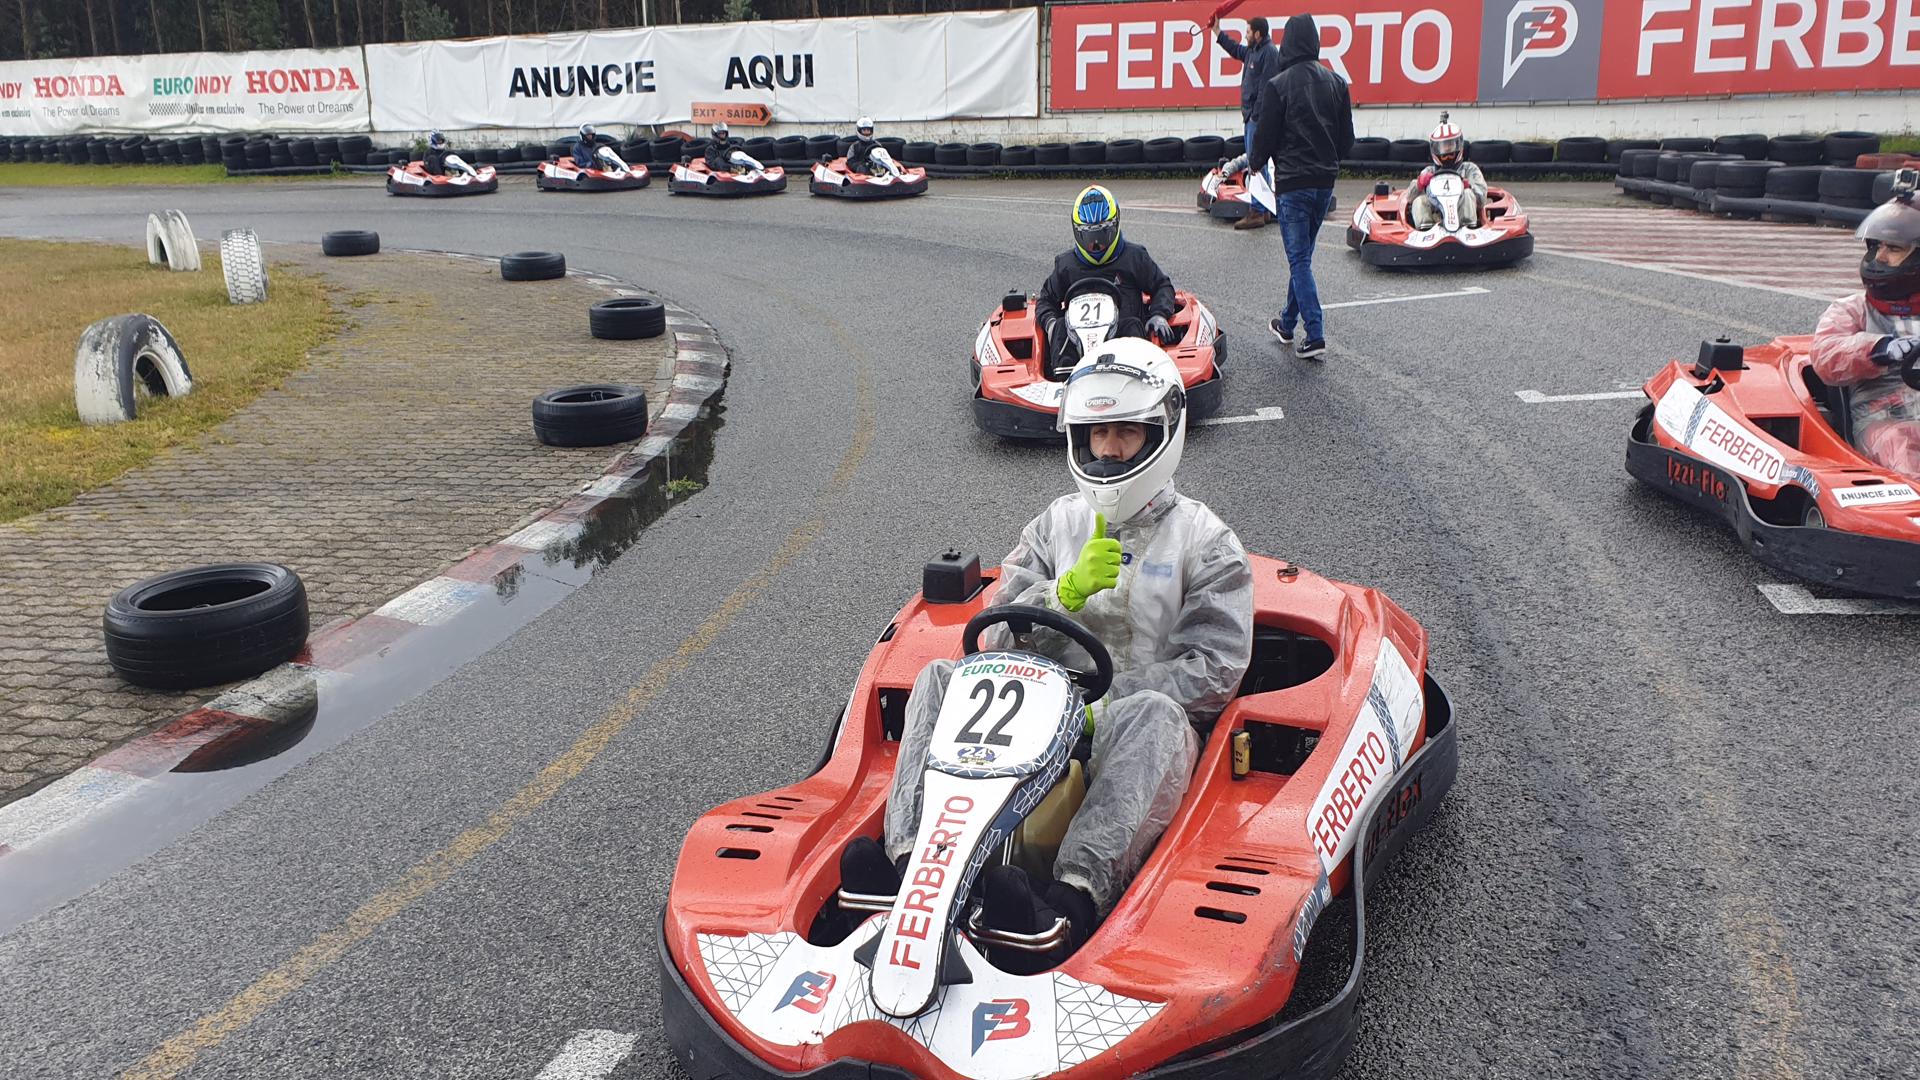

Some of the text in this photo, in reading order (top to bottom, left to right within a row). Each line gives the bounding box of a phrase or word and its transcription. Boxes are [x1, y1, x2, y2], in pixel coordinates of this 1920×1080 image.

[245, 67, 360, 94] HONDA
[508, 53, 815, 98] ANUNCIE AQUI
[33, 74, 125, 98] HONDA
[153, 75, 232, 96] EUROINDY
[42, 106, 55, 117] The
[57, 105, 79, 117] Power
[89, 104, 120, 116] Dreams
[205, 106, 215, 114] em
[216, 102, 245, 115] exclusivo
[258, 101, 354, 115] The Power of Dreams
[692, 108, 716, 117] EXIT
[726, 108, 758, 118] SAÍDA
[1443, 179, 1450, 192] 4
[1080, 302, 1101, 321] 21
[1095, 363, 1141, 377] EUROPA
[1700, 418, 1780, 480] FERBERTO
[1841, 488, 1913, 501] ANUNCIE AQUI
[961, 663, 1049, 681] EUROINDY
[954, 678, 1025, 747] 22
[889, 795, 975, 970] FERBERTO
